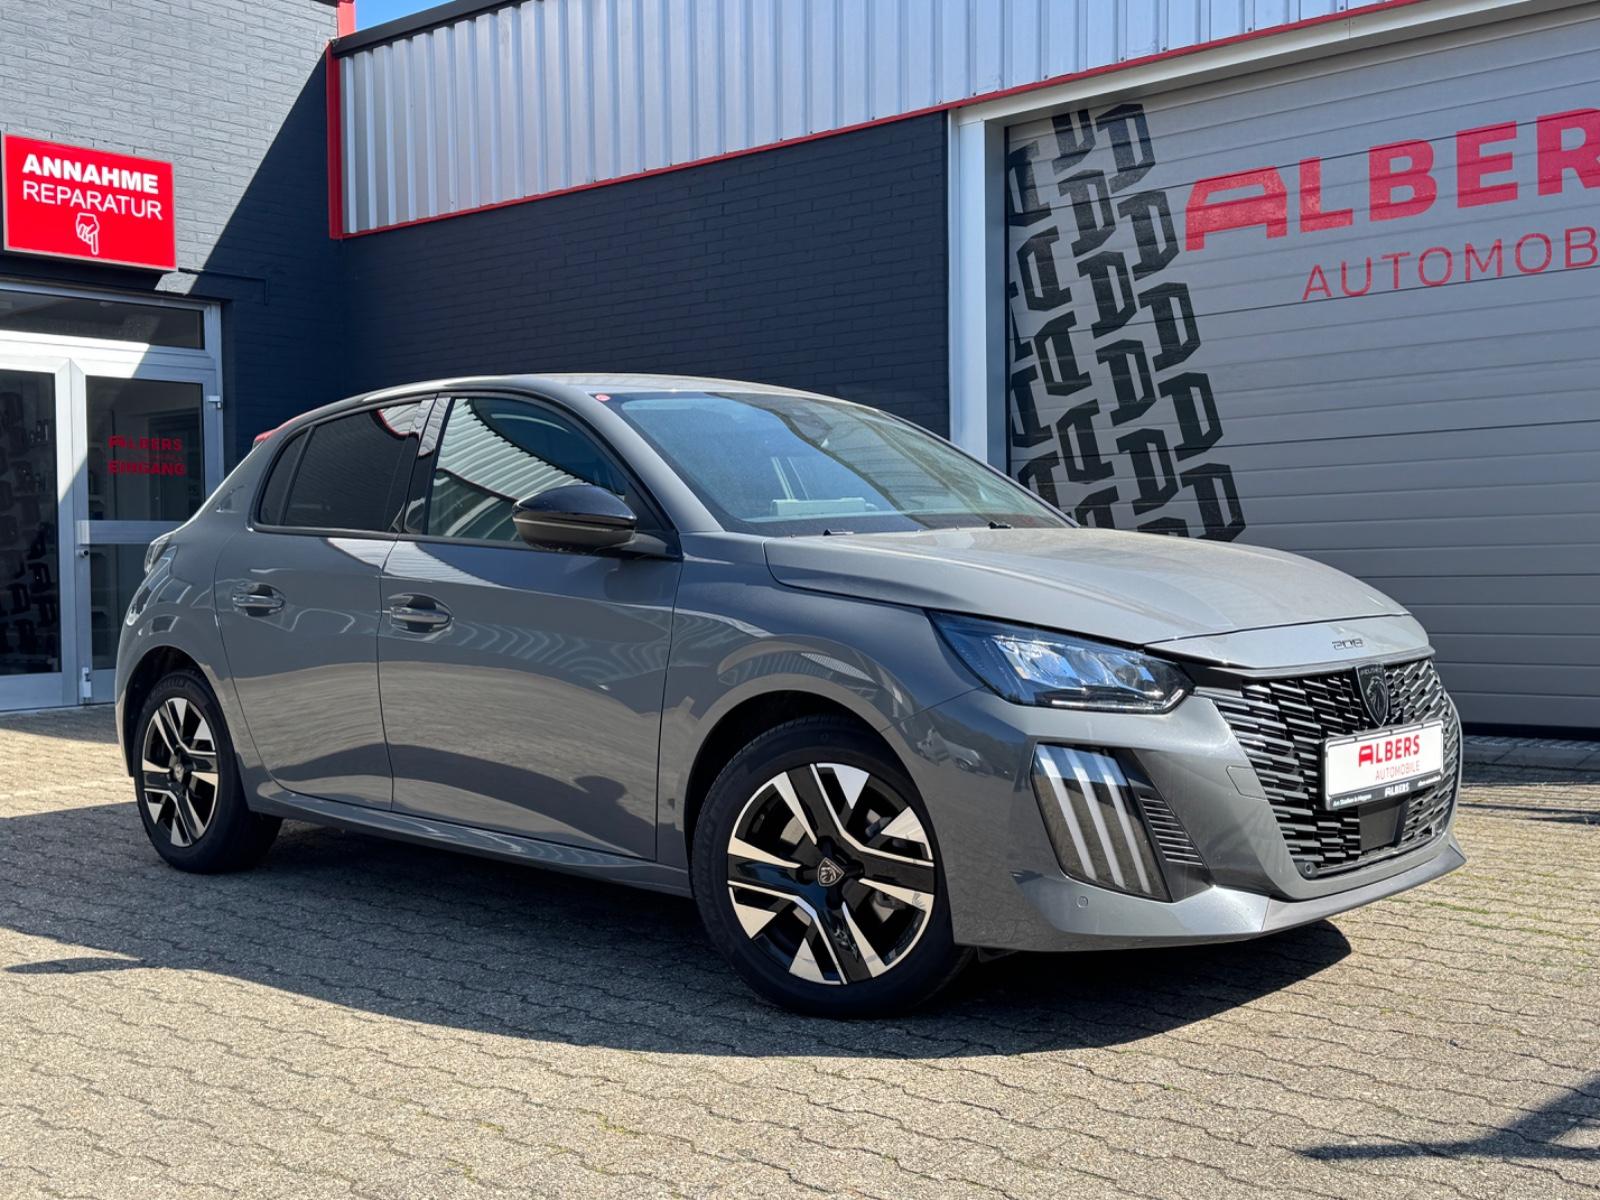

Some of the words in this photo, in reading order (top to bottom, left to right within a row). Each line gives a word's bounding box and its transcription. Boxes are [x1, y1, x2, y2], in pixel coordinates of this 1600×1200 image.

[22, 153, 159, 194] ANNAHME
[22, 180, 163, 220] REPARATUR
[1302, 226, 1599, 301] AUTOMOB
[1332, 638, 1364, 650] 208
[1358, 735, 1421, 767] ALBERS
[1375, 760, 1421, 781] AUTOMOBILE
